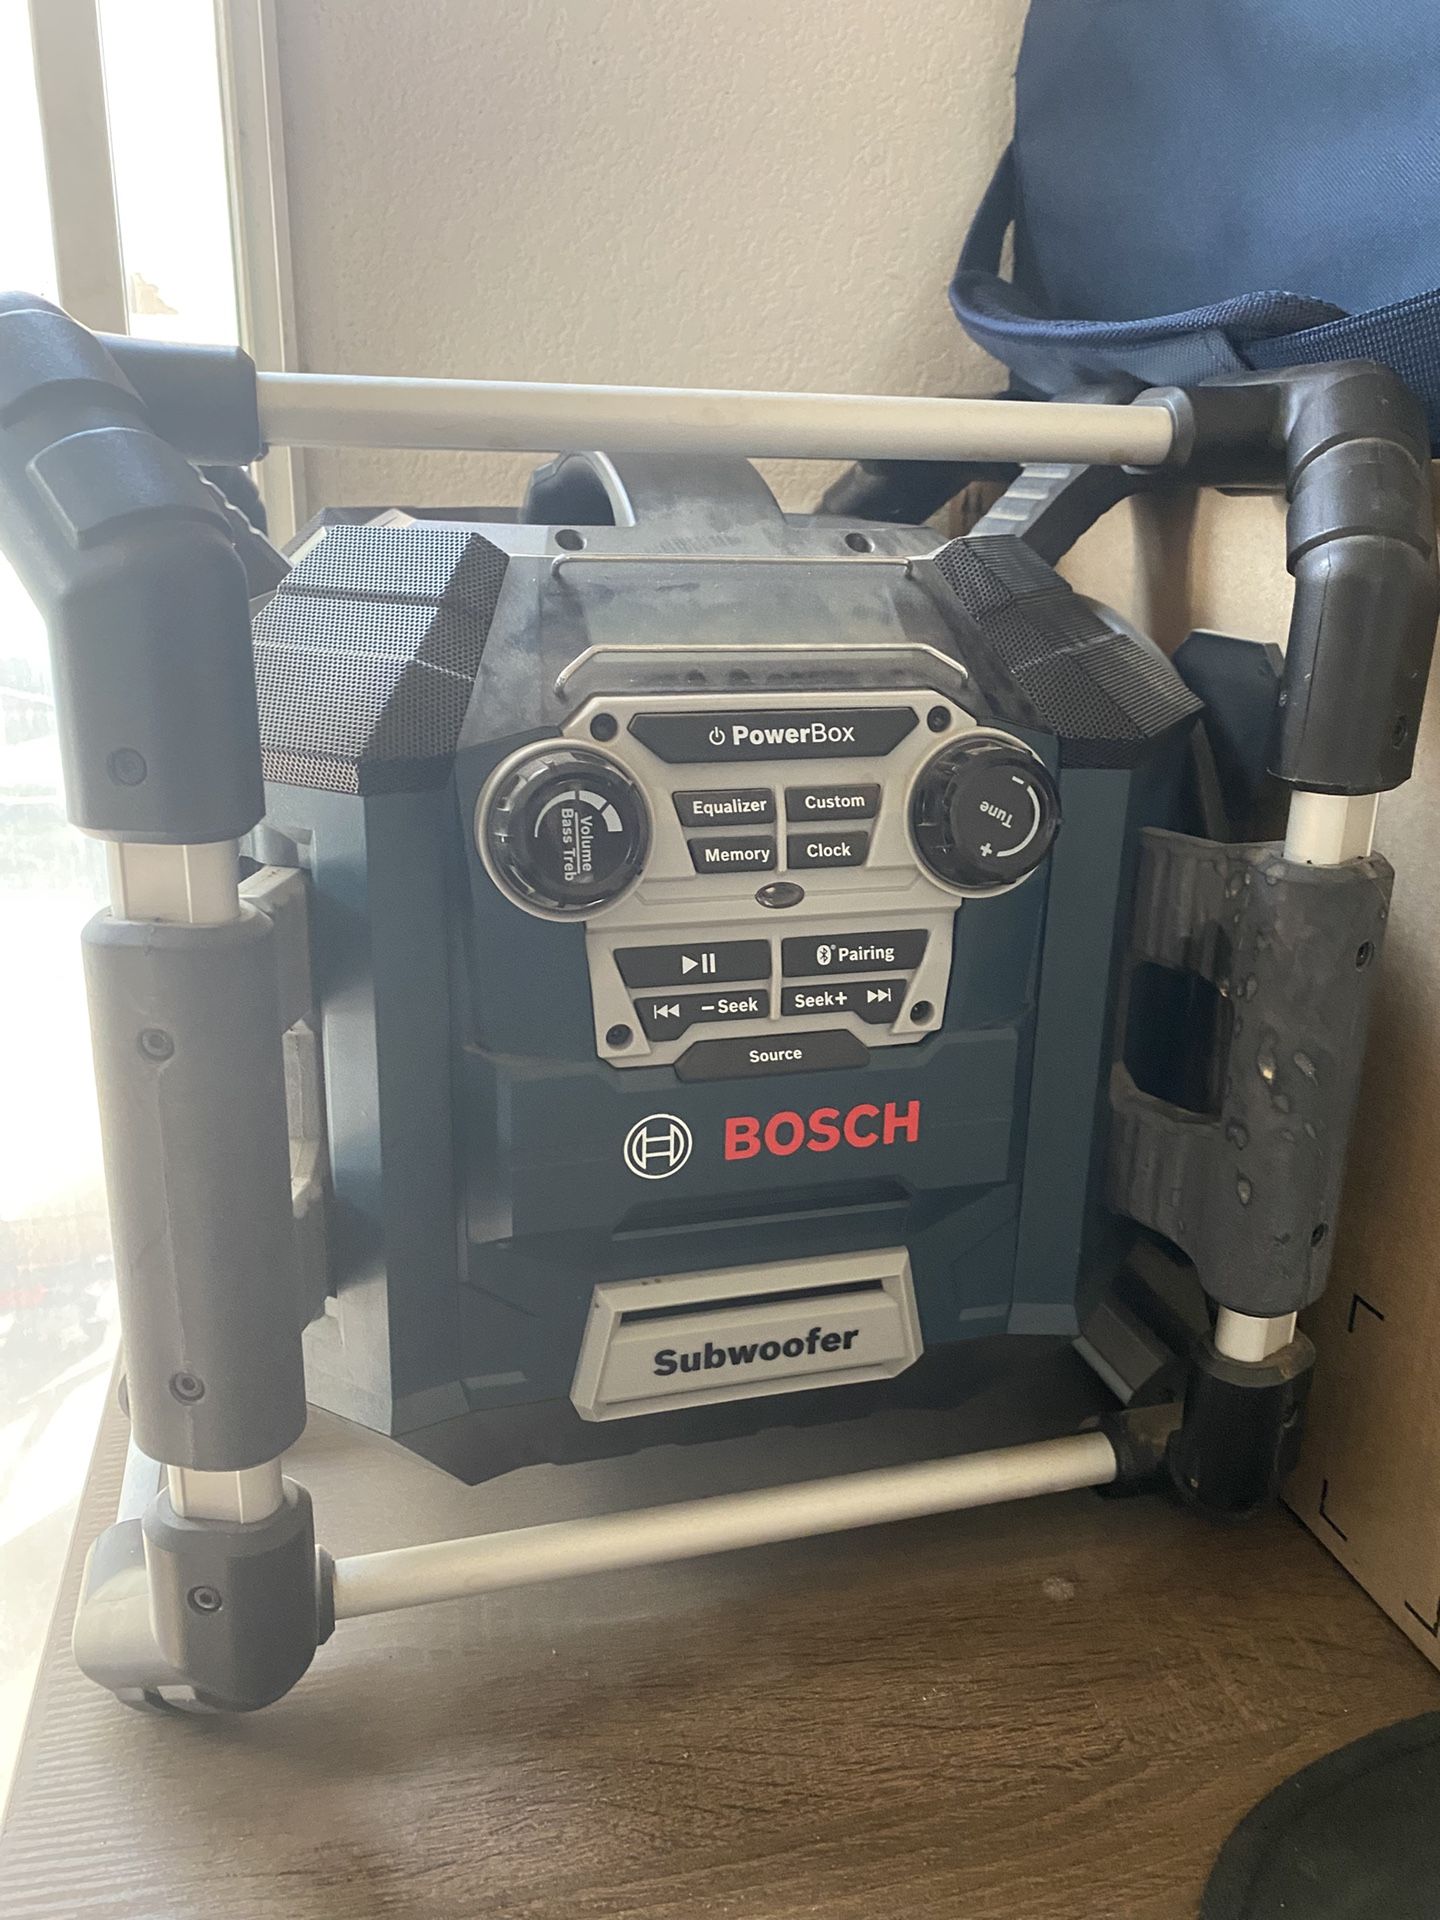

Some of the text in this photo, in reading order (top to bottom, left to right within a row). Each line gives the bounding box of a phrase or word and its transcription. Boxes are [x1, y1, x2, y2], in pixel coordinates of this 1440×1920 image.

[731, 722, 856, 746] PowerBox
[692, 797, 768, 817] Equalizer
[804, 793, 866, 811] Custom
[979, 800, 1013, 829] Tune
[561, 808, 578, 881] Bass Treb
[579, 815, 593, 872] Volume
[806, 841, 852, 859] Clock
[704, 845, 771, 867] Memory
[838, 945, 895, 963] Pairing
[749, 1047, 803, 1064] Source
[724, 1099, 921, 1161] BOSCH
[653, 1326, 860, 1377] Subwoofer
